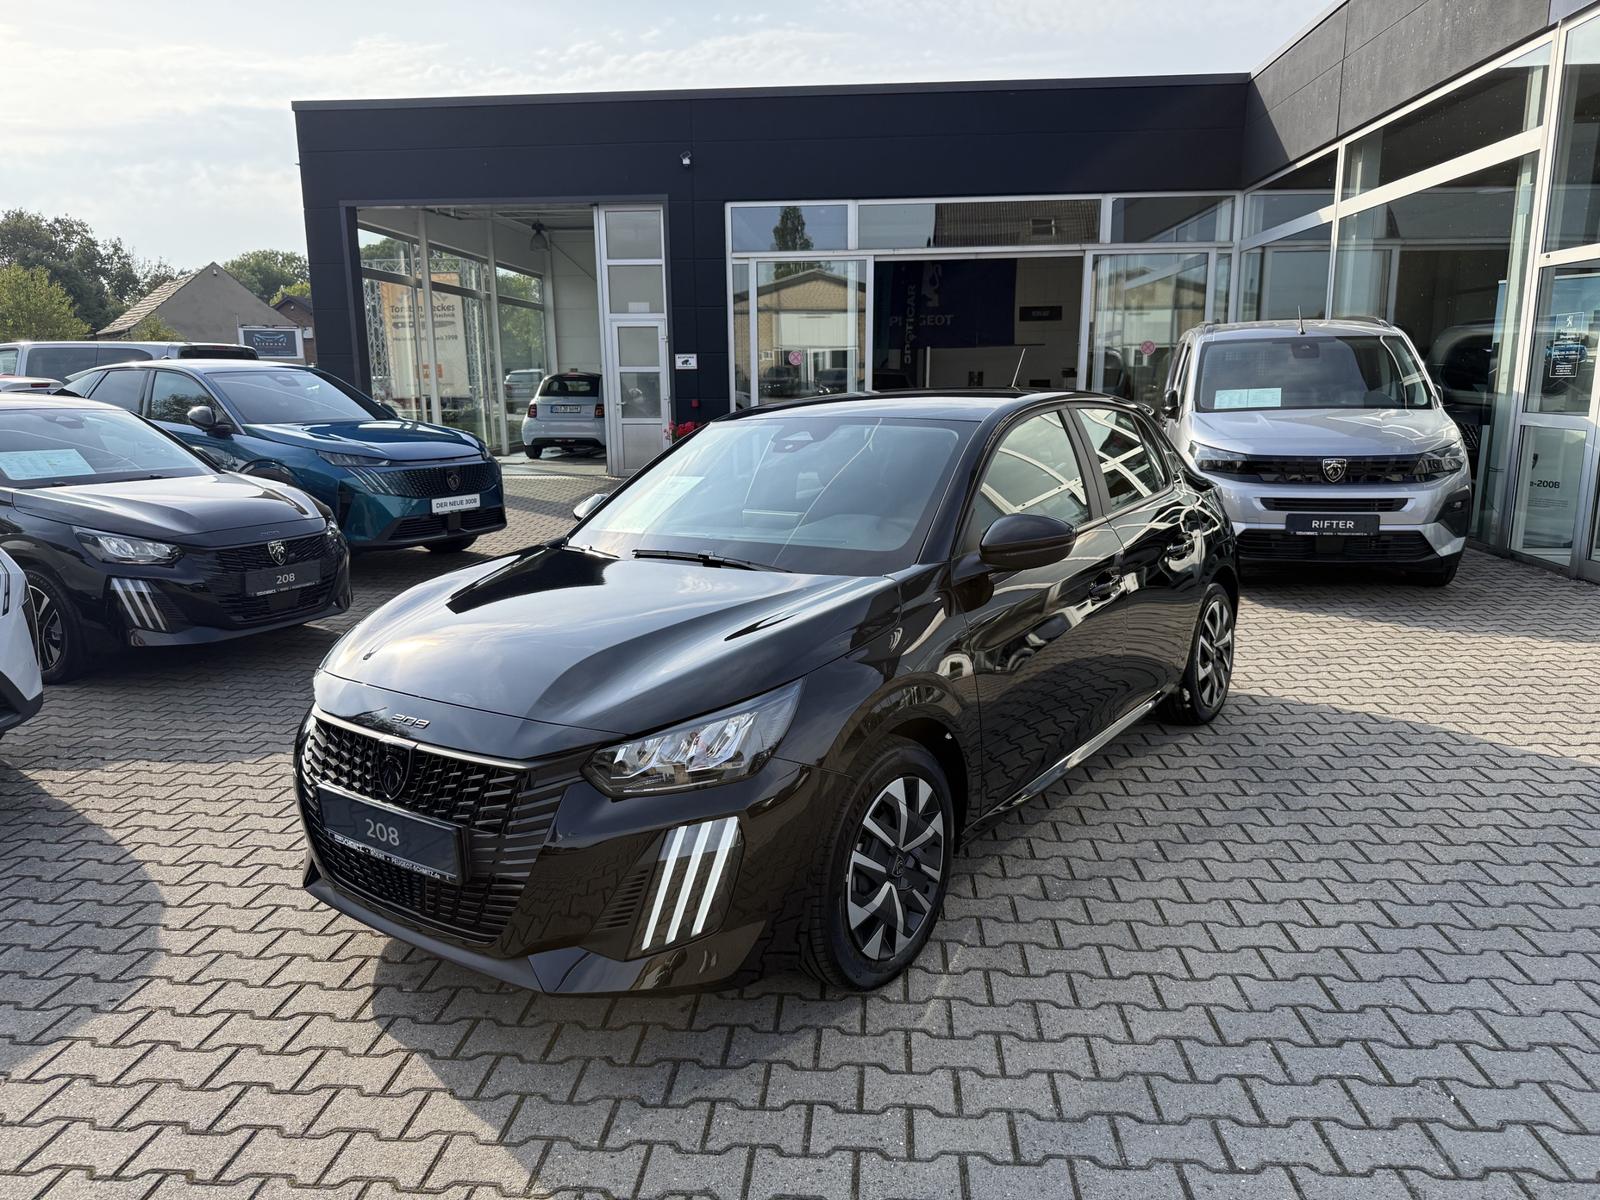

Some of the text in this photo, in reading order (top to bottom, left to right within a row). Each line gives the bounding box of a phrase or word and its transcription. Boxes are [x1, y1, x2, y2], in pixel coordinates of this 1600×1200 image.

[889, 315, 954, 326] PGEOT
[1311, 520, 1354, 529] RIFTER
[276, 573, 295, 584] 208
[391, 713, 430, 729] 208
[365, 818, 399, 846] 208
